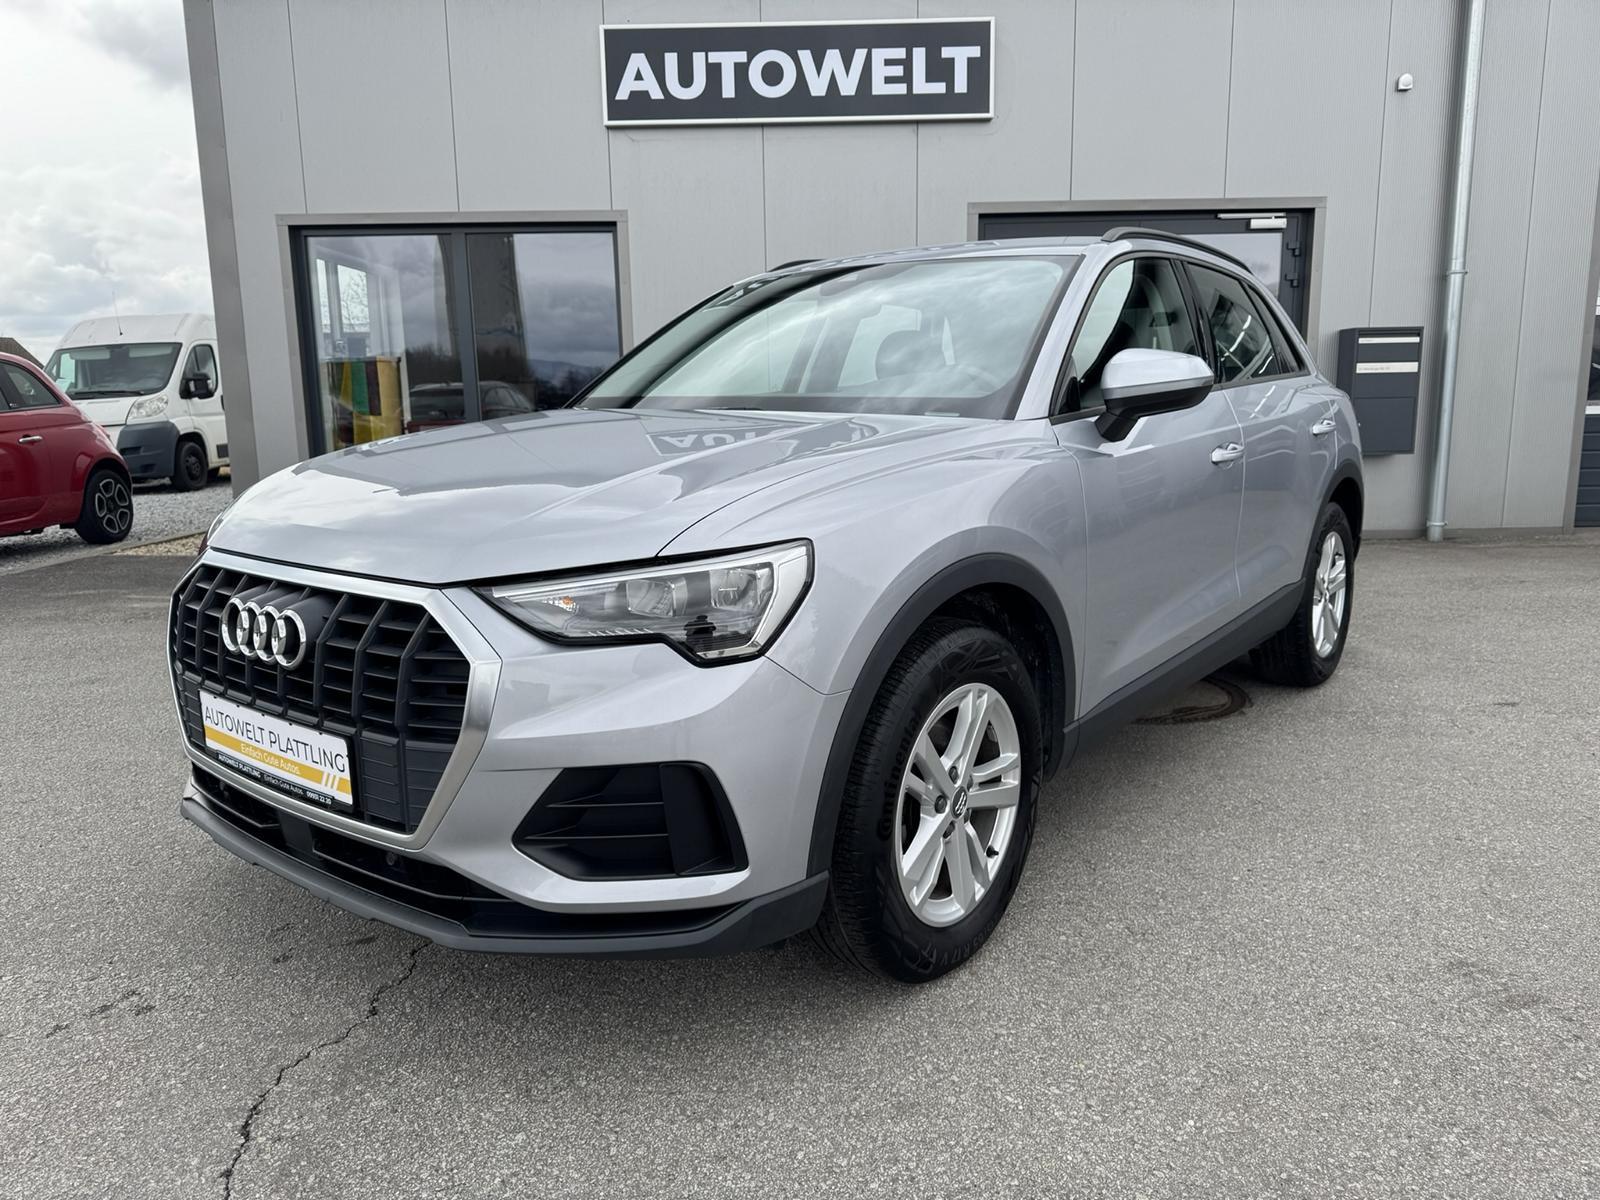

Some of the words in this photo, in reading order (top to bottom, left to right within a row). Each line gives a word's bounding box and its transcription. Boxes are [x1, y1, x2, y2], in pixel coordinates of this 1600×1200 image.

[614, 45, 981, 101] AUTOWELT
[205, 706, 265, 745] AUTOWELT
[268, 730, 346, 773] PLATTLING
